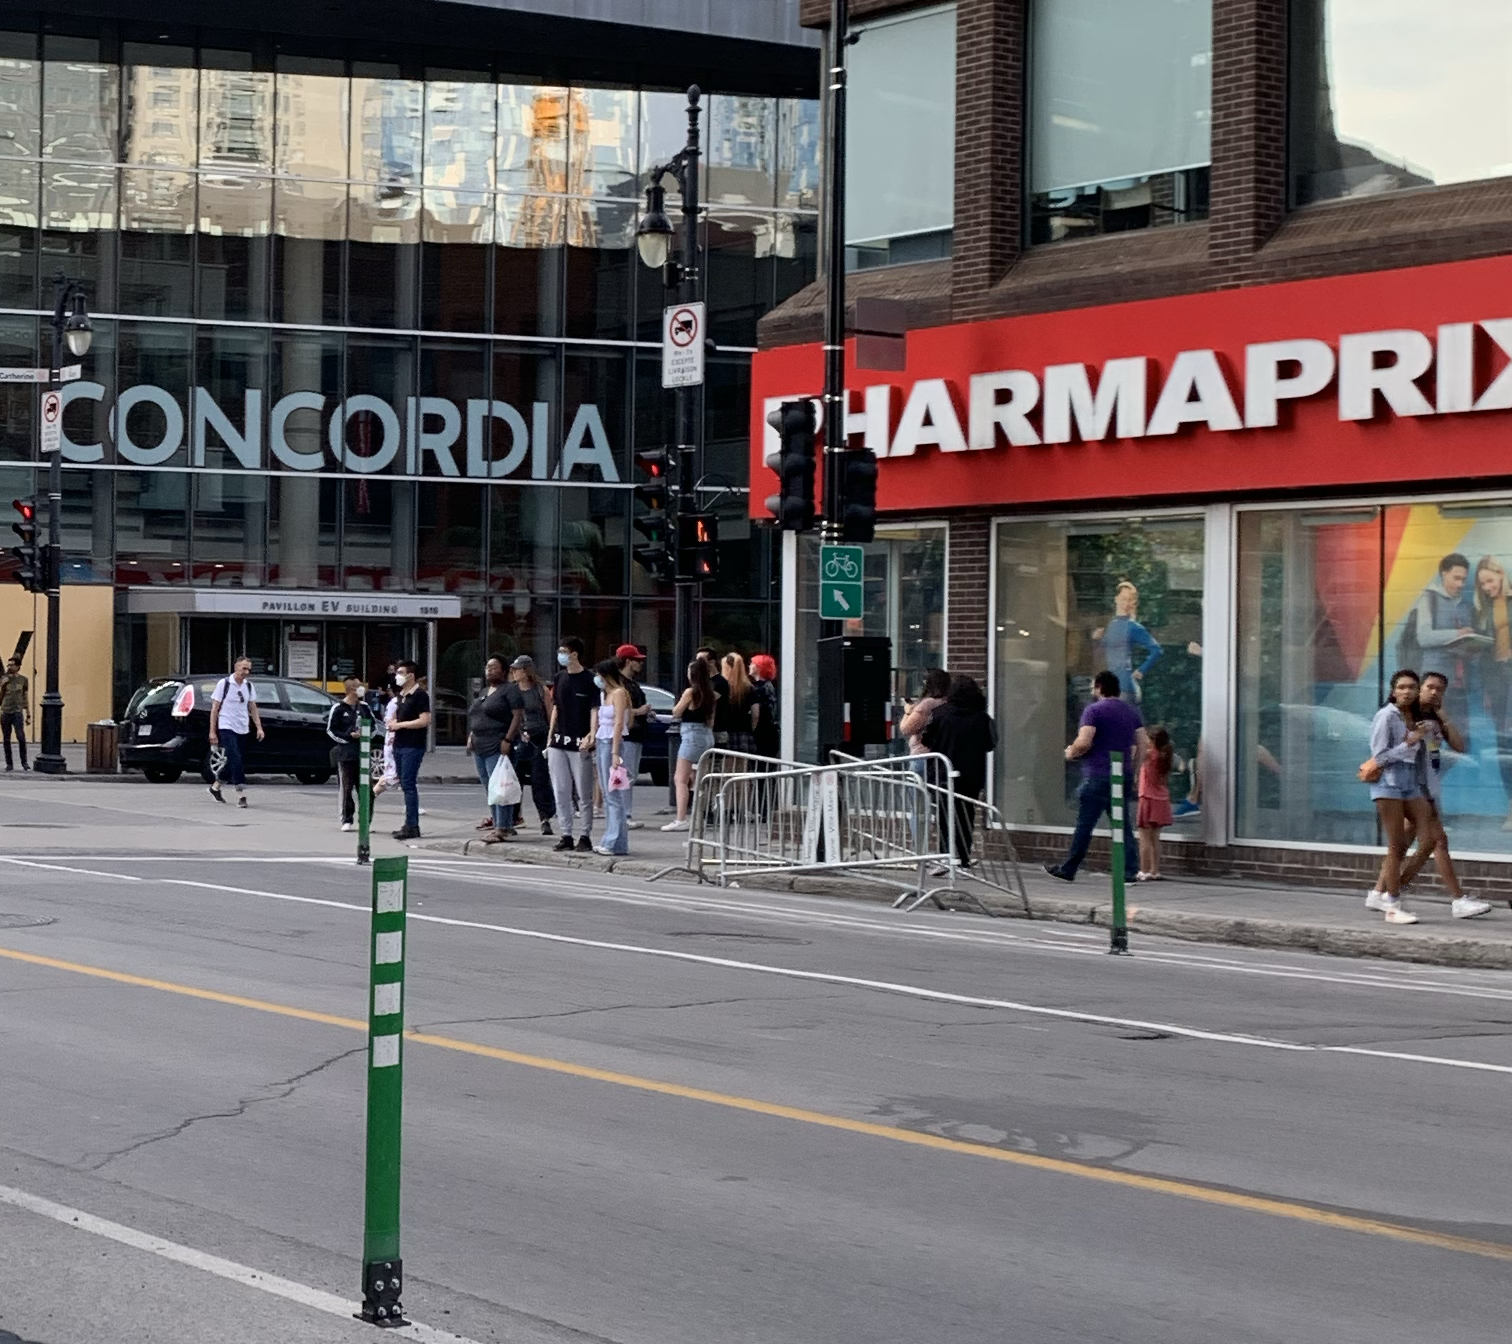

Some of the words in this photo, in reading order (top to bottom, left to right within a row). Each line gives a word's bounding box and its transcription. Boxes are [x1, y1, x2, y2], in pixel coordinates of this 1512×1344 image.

[59, 381, 620, 483] CONCORDIA
[262, 601, 316, 612] PAVILLON
[321, 601, 340, 613] EV
[345, 603, 398, 614] BUILDING
